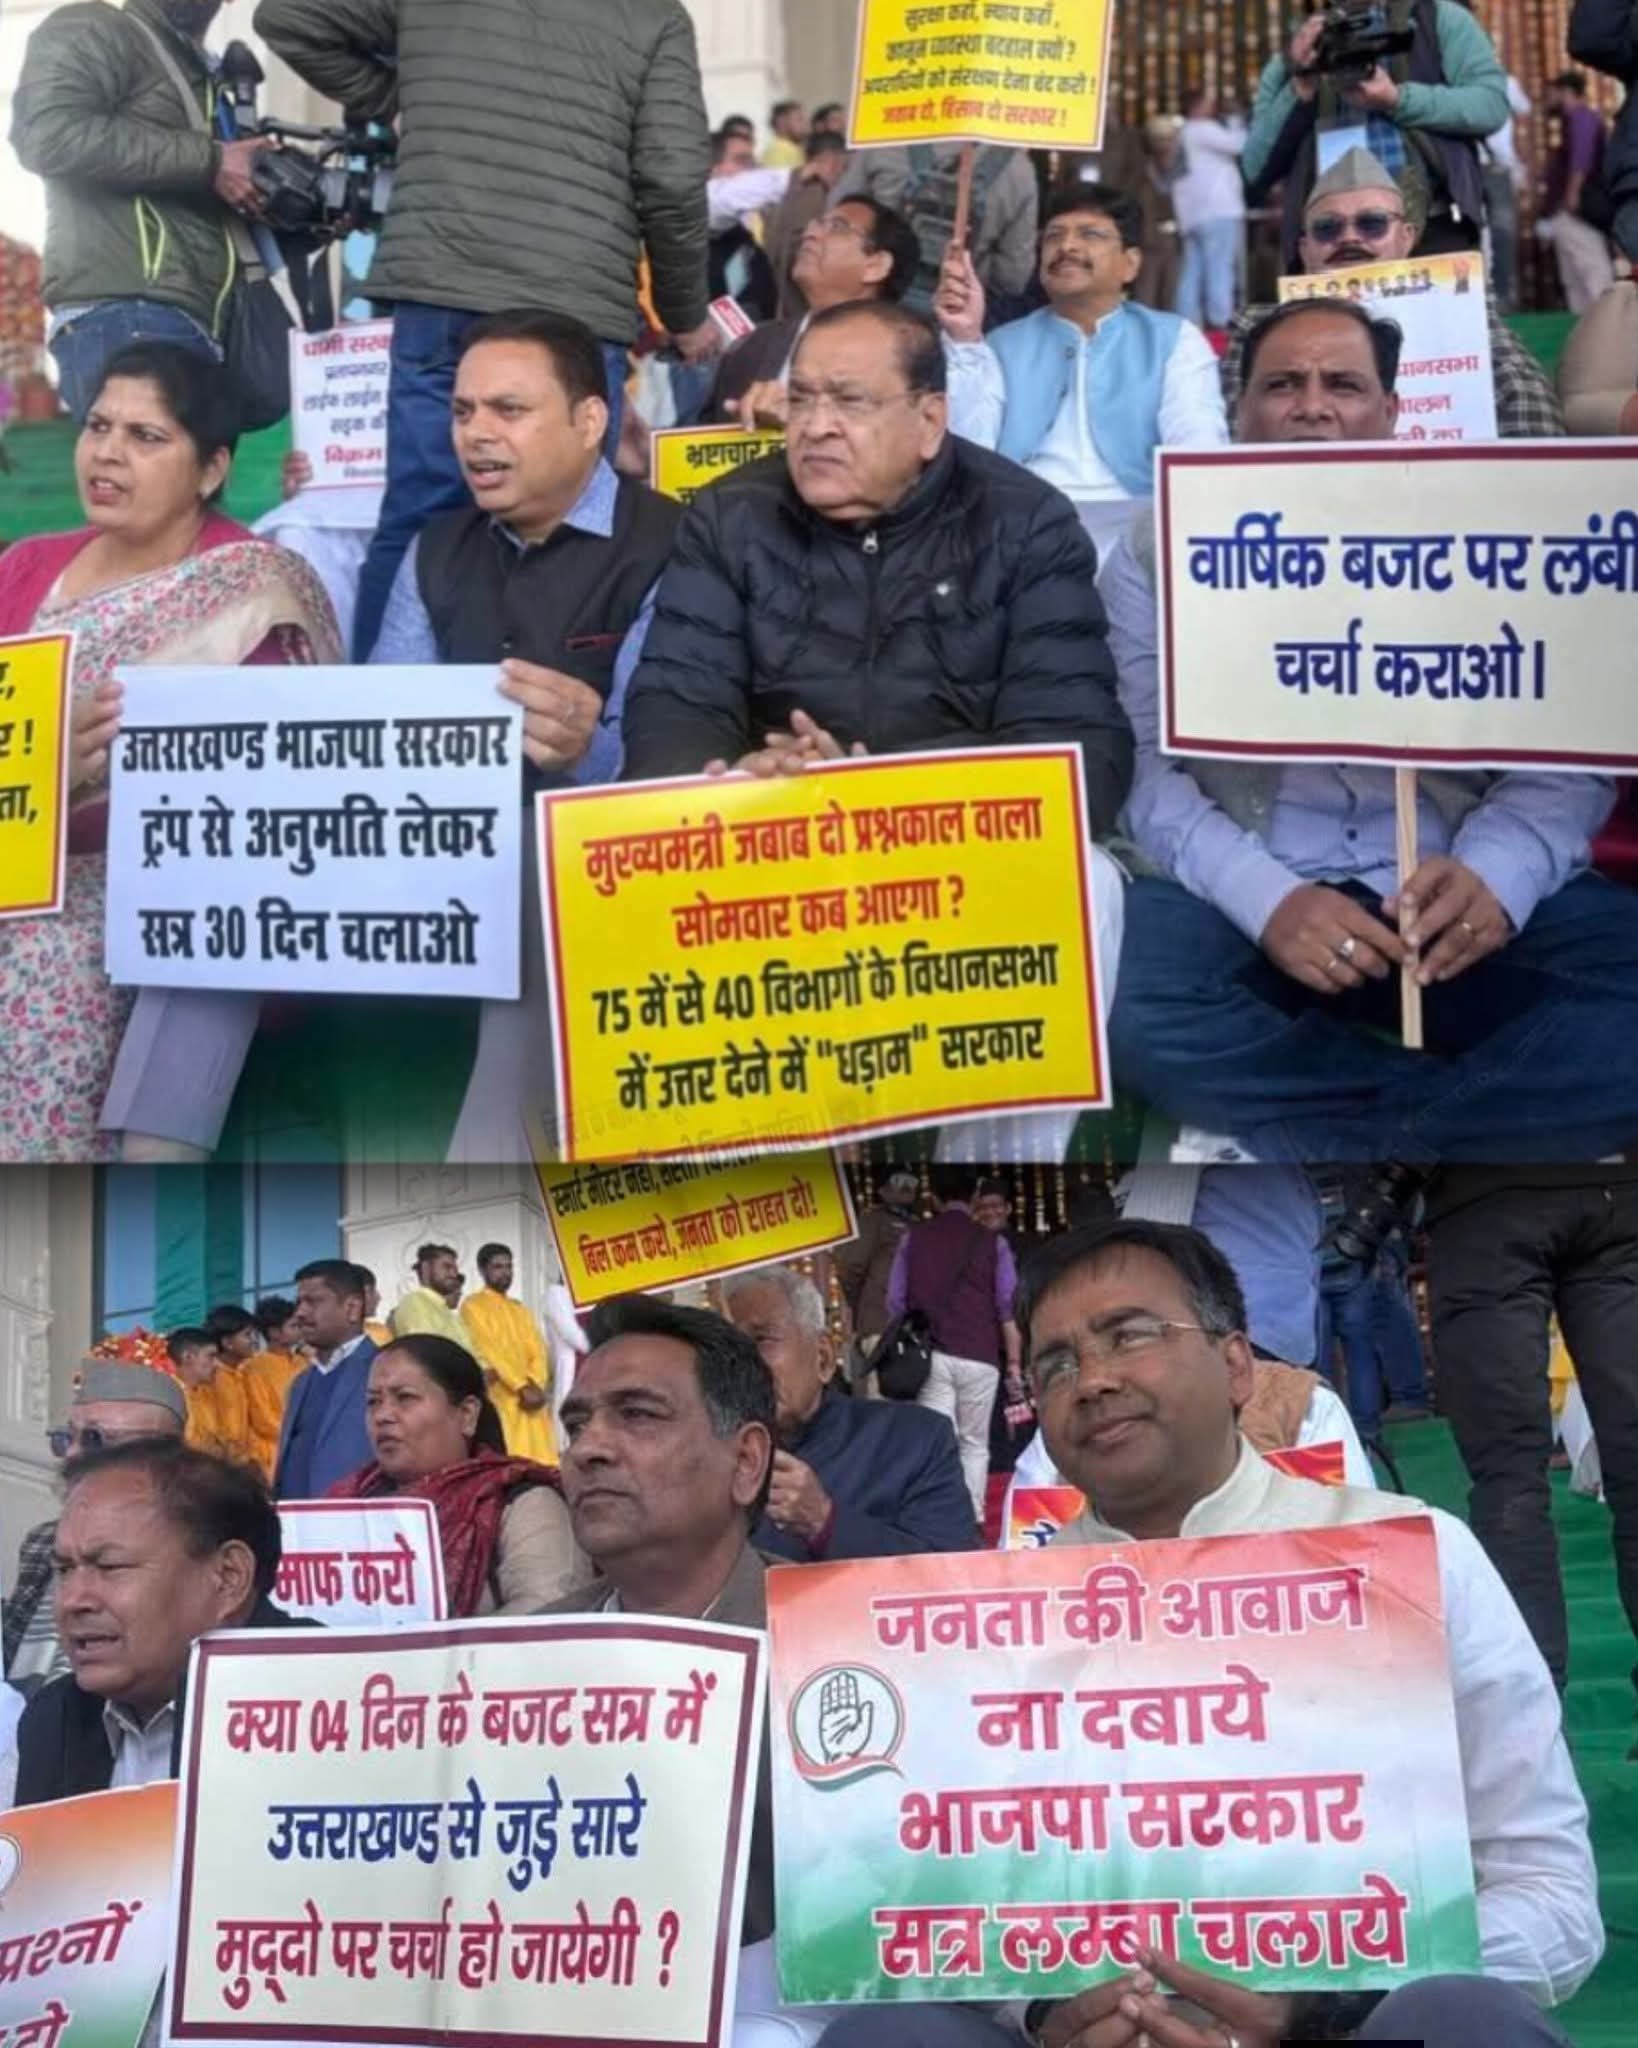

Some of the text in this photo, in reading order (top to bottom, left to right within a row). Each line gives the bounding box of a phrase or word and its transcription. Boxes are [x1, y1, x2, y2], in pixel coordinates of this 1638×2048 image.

[1188, 510, 1638, 594] वार्षिक बजट पर लंबी
[1274, 618, 1362, 695] चर्चा
[119, 717, 512, 772] उत्तराखण्ड भाजपा सरकार
[140, 793, 498, 876] ट्रंप से अनुमति लेकर
[583, 797, 1042, 897] मुख्यमंत्री जबाब दो प्रश्नकाल वाला
[138, 897, 479, 965] सत्र 30 दिन चलाओ
[672, 892, 790, 949] सोमवार
[797, 888, 847, 934] कब
[855, 878, 941, 926] आएगा
[592, 939, 1058, 1034] 75 में से 40 विभागों के विधानसभा
[616, 1052, 651, 1111] में
[652, 1060, 716, 1110] उत्तर
[719, 1037, 771, 1098] देने
[778, 1036, 811, 1093] में
[939, 1018, 1044, 1069] सरकार
[578, 1232, 611, 1278] बिल
[610, 1226, 642, 1269] कम
[672, 1208, 719, 1253] जनता
[717, 1194, 744, 1240] को
[745, 1187, 789, 1231] राहत
[276, 1532, 416, 1606] माफ करो
[872, 1565, 1368, 1652] जनता की आवाज
[227, 1669, 717, 1753] क्या 04 दिन के बजट सत्र में
[972, 1665, 1269, 1749] ना दबाये
[267, 1773, 647, 1892] उत्तराखण्ड से जुड़े सारे
[900, 1773, 1365, 1855] भाजपा सरकार
[331, 1921, 382, 1978] पर
[389, 1897, 451, 1980] चर्चा
[457, 1900, 503, 1987] हो
[511, 1896, 641, 1988] जायेगी
[876, 1874, 1407, 1976] सत्र लम्बा चलाये
